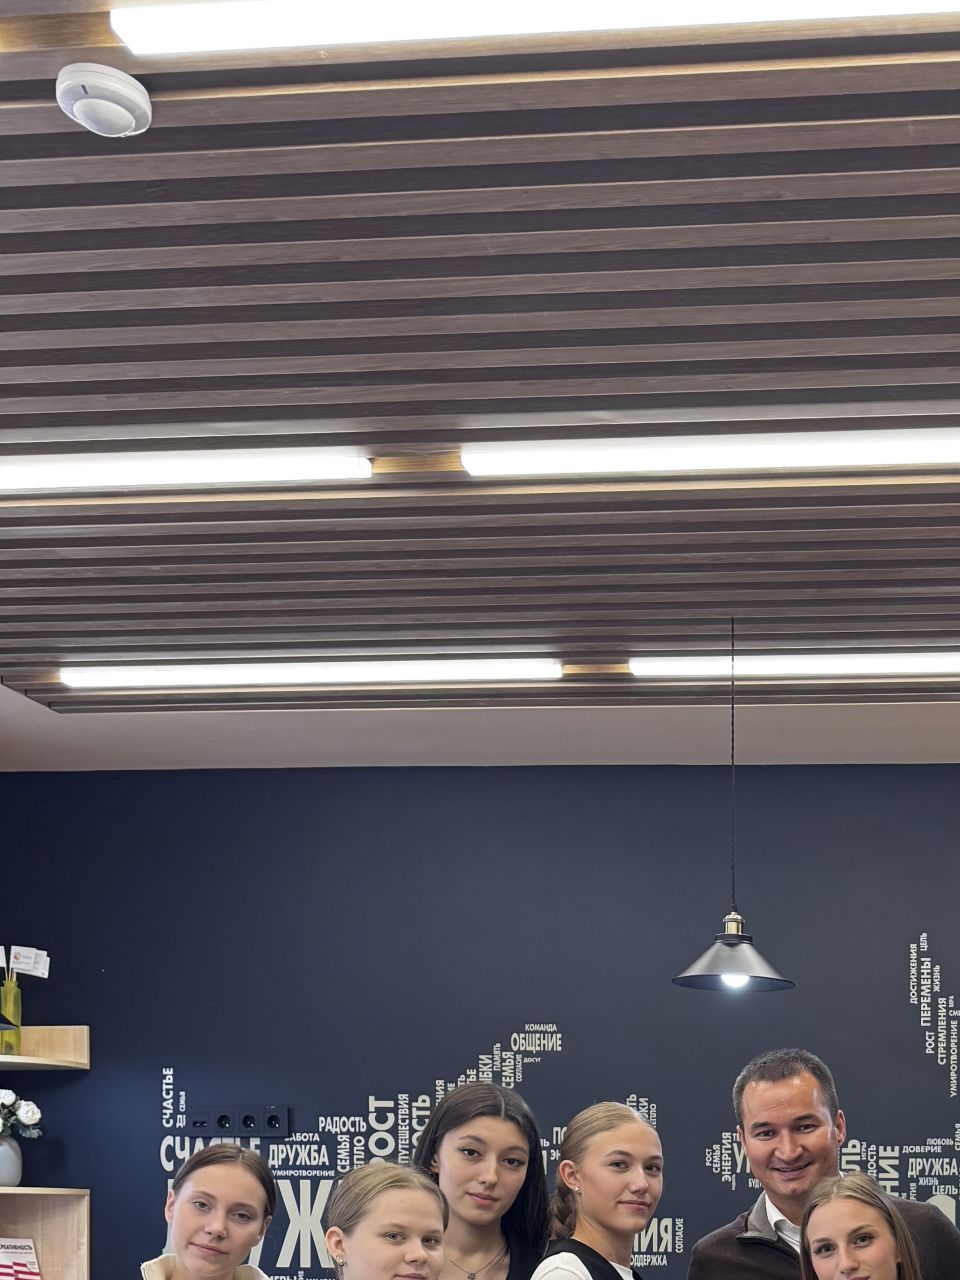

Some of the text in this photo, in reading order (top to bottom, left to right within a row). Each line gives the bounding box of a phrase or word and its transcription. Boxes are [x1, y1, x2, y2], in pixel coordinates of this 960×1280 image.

[920, 932, 928, 951] ЦЕЛЬ
[910, 943, 918, 1004] ДОСТИЖЕНИЯ
[920, 957, 931, 1027] ПЕРЕМЕНЫ
[525, 1023, 557, 1032] КОМАНДА
[938, 997, 946, 1065] СТРЕМЛЕНИЯ
[511, 1032, 562, 1053] ОБЩЕНИЕ
[926, 1031, 934, 1054] РОСТ
[493, 1042, 501, 1071] ПАМЯТЬ
[502, 1051, 514, 1089] СЕМЬЯ
[162, 1067, 173, 1128] СЧАСТЬЕ
[319, 1115, 367, 1134] РАДОСТЬ
[398, 1093, 409, 1164] ПУТЕШЕСТВИЯ
[336, 1134, 350, 1173] СЕМЬЯ
[902, 1145, 942, 1154] ДОВЕРИЕ
[926, 1138, 954, 1146] ЛЮБОВЬ
[268, 1144, 330, 1169] ДРУЖБА
[721, 1132, 732, 1182] ЭНЕРГИЯ
[907, 1157, 958, 1178] ДРУЖБА
[272, 1169, 336, 1177] УМИРОТВОРЕНИЕ
[918, 1176, 939, 1186] ЖИЗНЬ
[932, 1185, 959, 1196] ЦЕЛЬ
[675, 1217, 684, 1254] СОГЛАСИЕ
[630, 1254, 668, 1268] ОДДЕРЖКА
